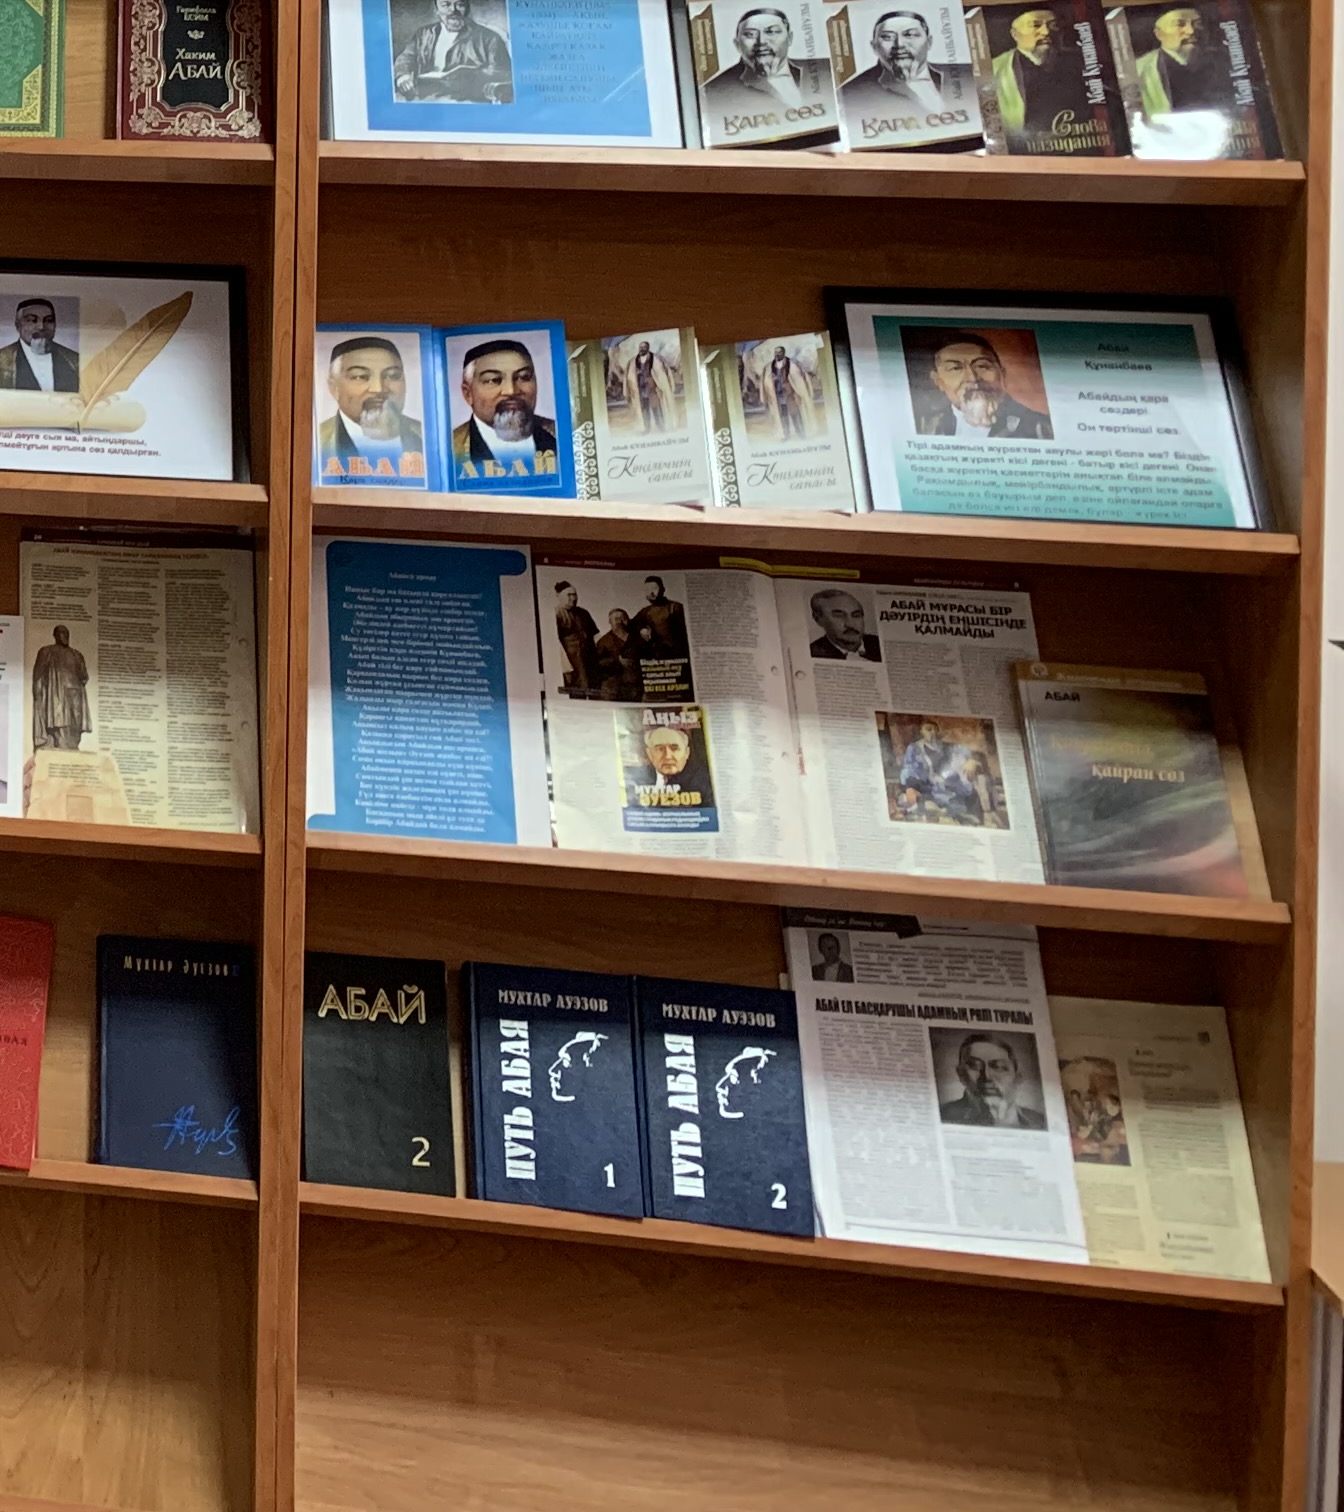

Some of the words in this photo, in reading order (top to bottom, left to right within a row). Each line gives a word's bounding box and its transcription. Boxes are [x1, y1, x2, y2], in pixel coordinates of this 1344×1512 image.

[175, 48, 216, 60] Хаким
[168, 62, 223, 81] АБАЙ
[785, 103, 827, 123] СӨЗ
[925, 109, 970, 128] СӨЗ
[322, 451, 425, 478] АБАЙ
[457, 449, 559, 479] АБАЙ
[880, 610, 946, 625] ДӘУІРДІҢ
[890, 599, 925, 610] АБАЙ
[929, 602, 986, 614] МҰРАСЫ
[989, 606, 1012, 616] БІР
[1044, 690, 1081, 702] АБАЙ
[317, 983, 427, 1026] АБАЙ
[497, 988, 553, 1009] МУХТАР
[554, 994, 610, 1014] АУЭЗОВ
[815, 996, 840, 1012] АБАЙ
[841, 999, 854, 1013] ЕЛ
[854, 1000, 916, 1018] БАСҚАРУШЫ
[917, 1005, 969, 1024] АДАМНЫҢ
[993, 1010, 1034, 1026] ТУРАЛЫ
[661, 1002, 718, 1024] МУХТАР
[720, 1008, 777, 1029] АУЭЗОВ
[498, 1018, 533, 1099] АБАЯ
[663, 1033, 700, 1115] АБАЯ
[411, 1136, 431, 1168] 2
[503, 1105, 537, 1181] ПУТЬ
[669, 1122, 706, 1199] ПУТЬ
[603, 1163, 616, 1188] 1
[771, 1183, 788, 1210] 2
